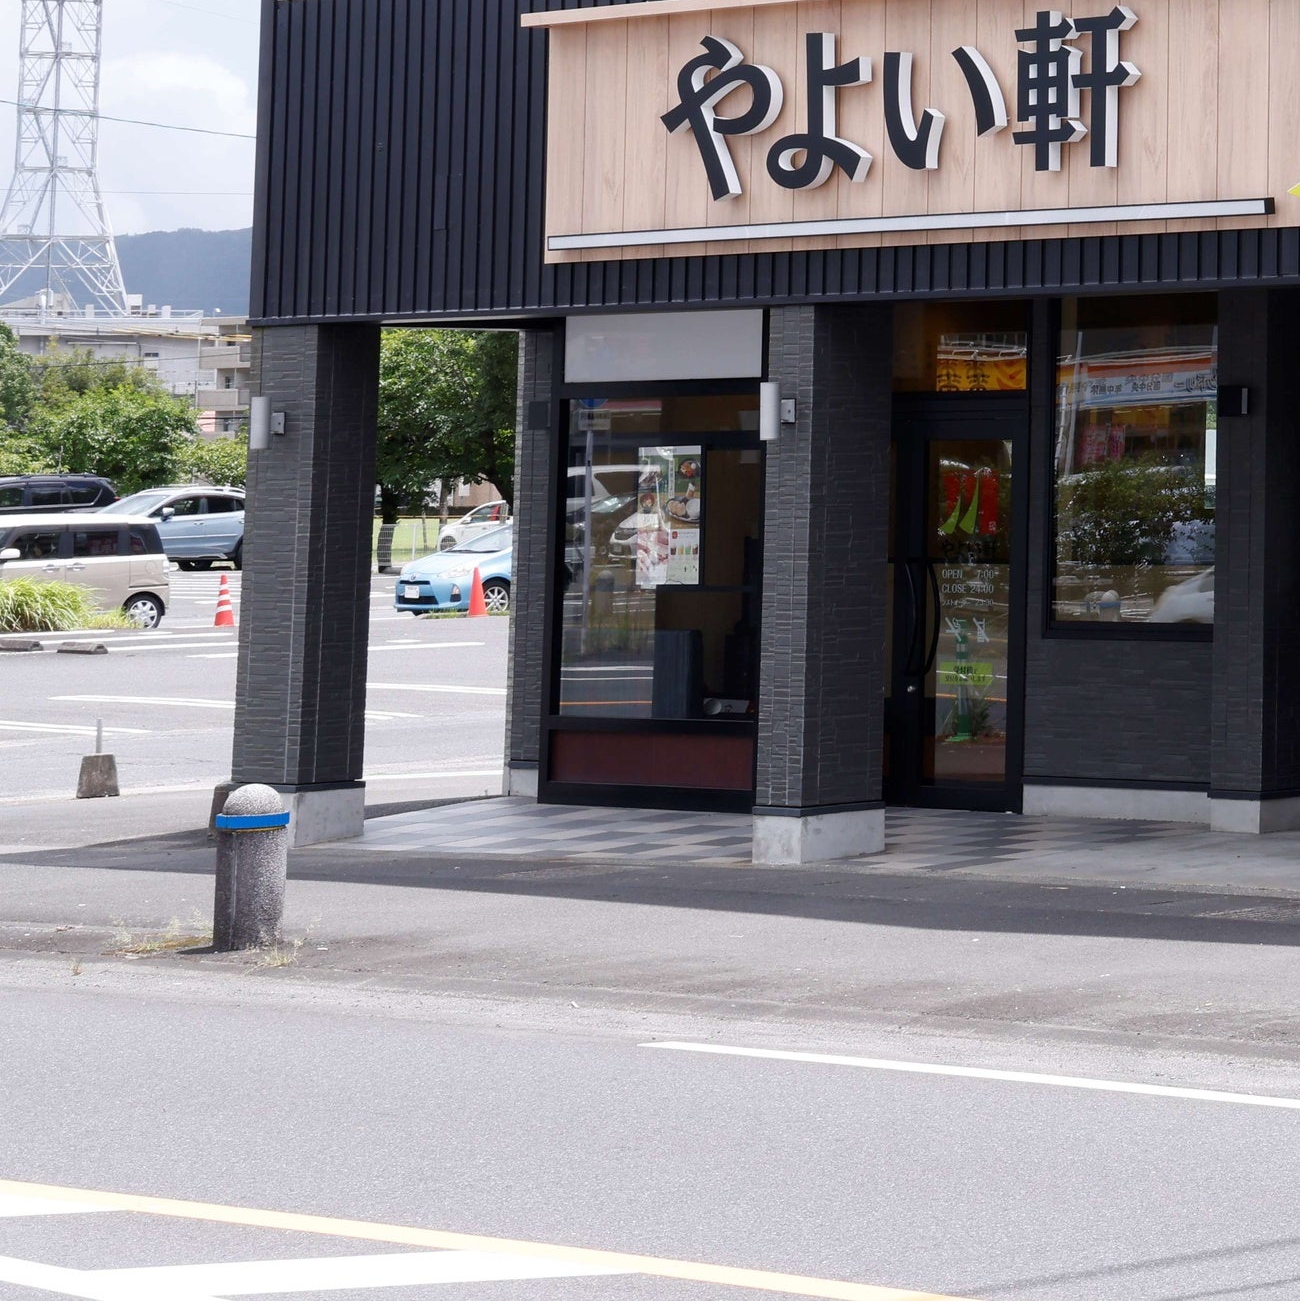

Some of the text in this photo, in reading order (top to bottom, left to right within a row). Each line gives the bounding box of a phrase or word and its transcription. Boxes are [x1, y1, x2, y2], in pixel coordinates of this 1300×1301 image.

[660, 5, 1142, 202] やよい軒
[942, 569, 995, 579] OPEN 7:00
[941, 583, 967, 594] CLOSE
